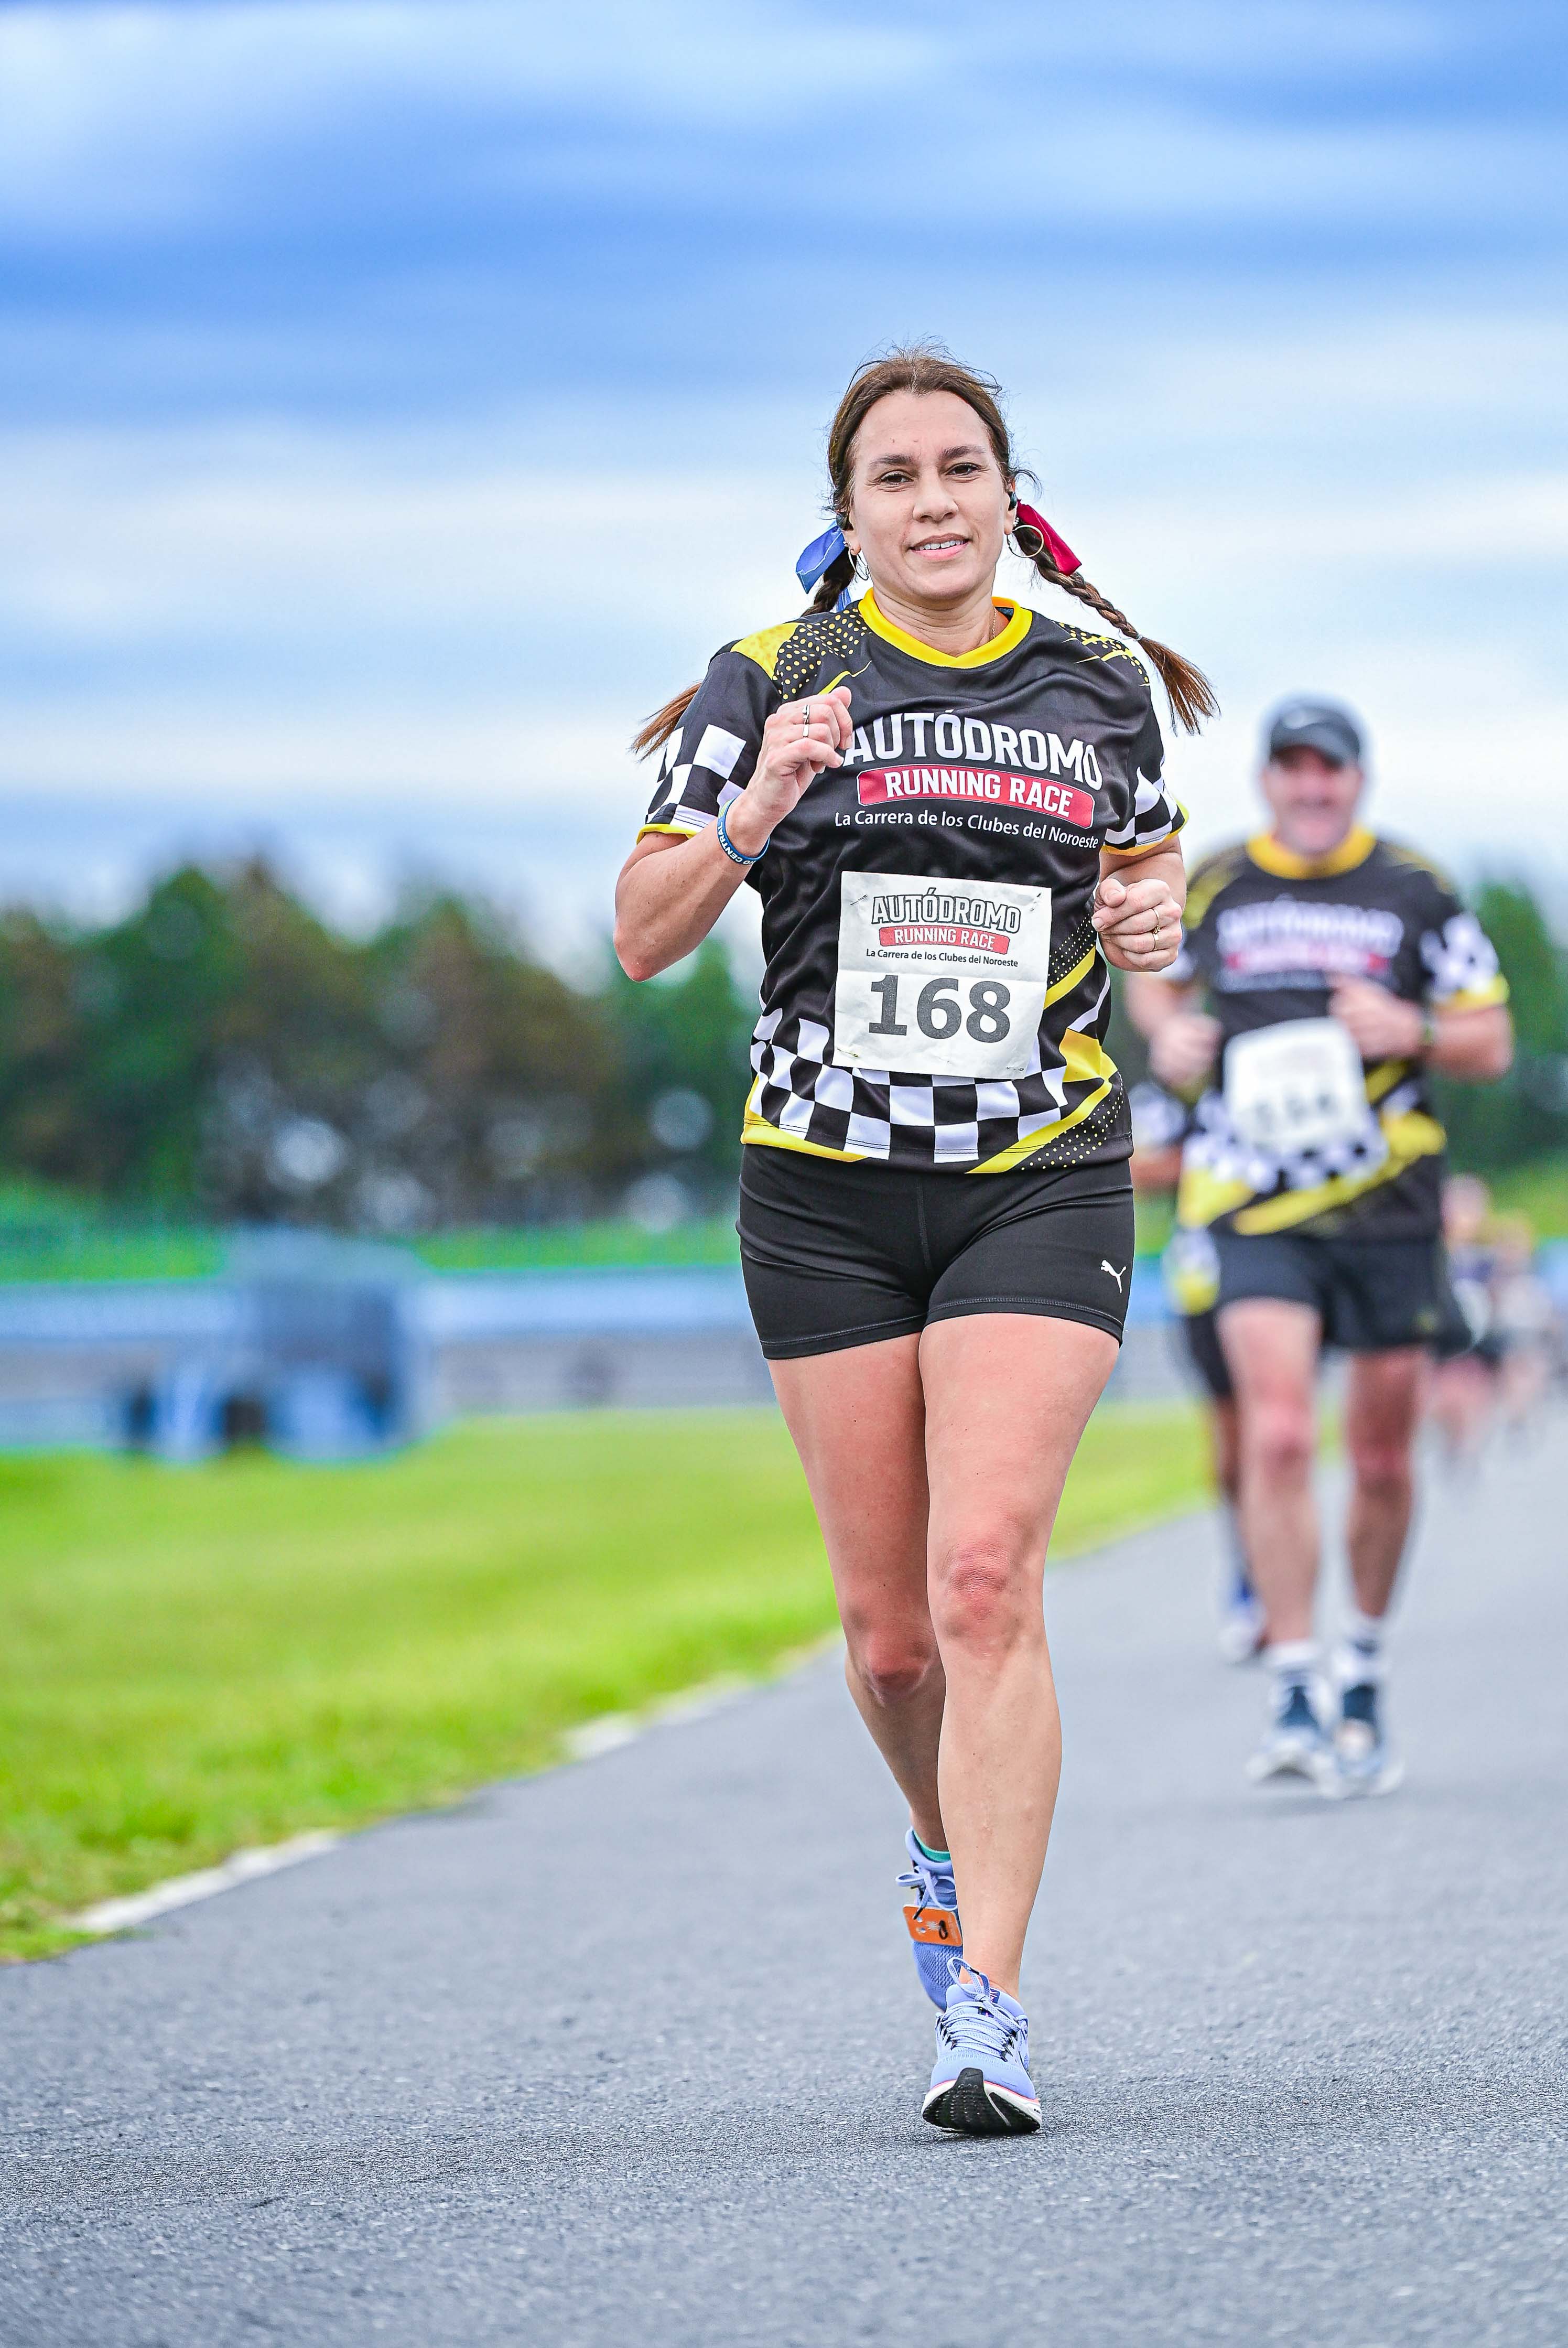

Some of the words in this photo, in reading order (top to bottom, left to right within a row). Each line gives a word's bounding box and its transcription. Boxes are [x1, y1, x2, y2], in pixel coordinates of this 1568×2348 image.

[842, 709, 1103, 791] AUTÓDROMO
[884, 768, 1002, 799] RUNNING
[1008, 776, 1074, 818] RACE
[717, 822, 743, 863] CENTRAL
[835, 812, 851, 826] La
[855, 810, 914, 825] Carrera
[917, 810, 938, 825] de
[941, 811, 964, 827] los
[967, 814, 1020, 835] Clubes
[1022, 822, 1047, 839] del
[1048, 826, 1099, 849] Noroeste
[871, 887, 1021, 934] AUTÓDROMO
[866, 948, 875, 957] La
[877, 950, 909, 958] Carrera
[911, 951, 922, 960] de
[924, 951, 937, 961] los
[939, 952, 967, 963] Clubes
[968, 955, 981, 964] del
[983, 956, 1019, 967] Noroeste
[894, 927, 957, 944] RUNNING
[960, 930, 996, 950] RACE
[869, 974, 1011, 1043] 168
